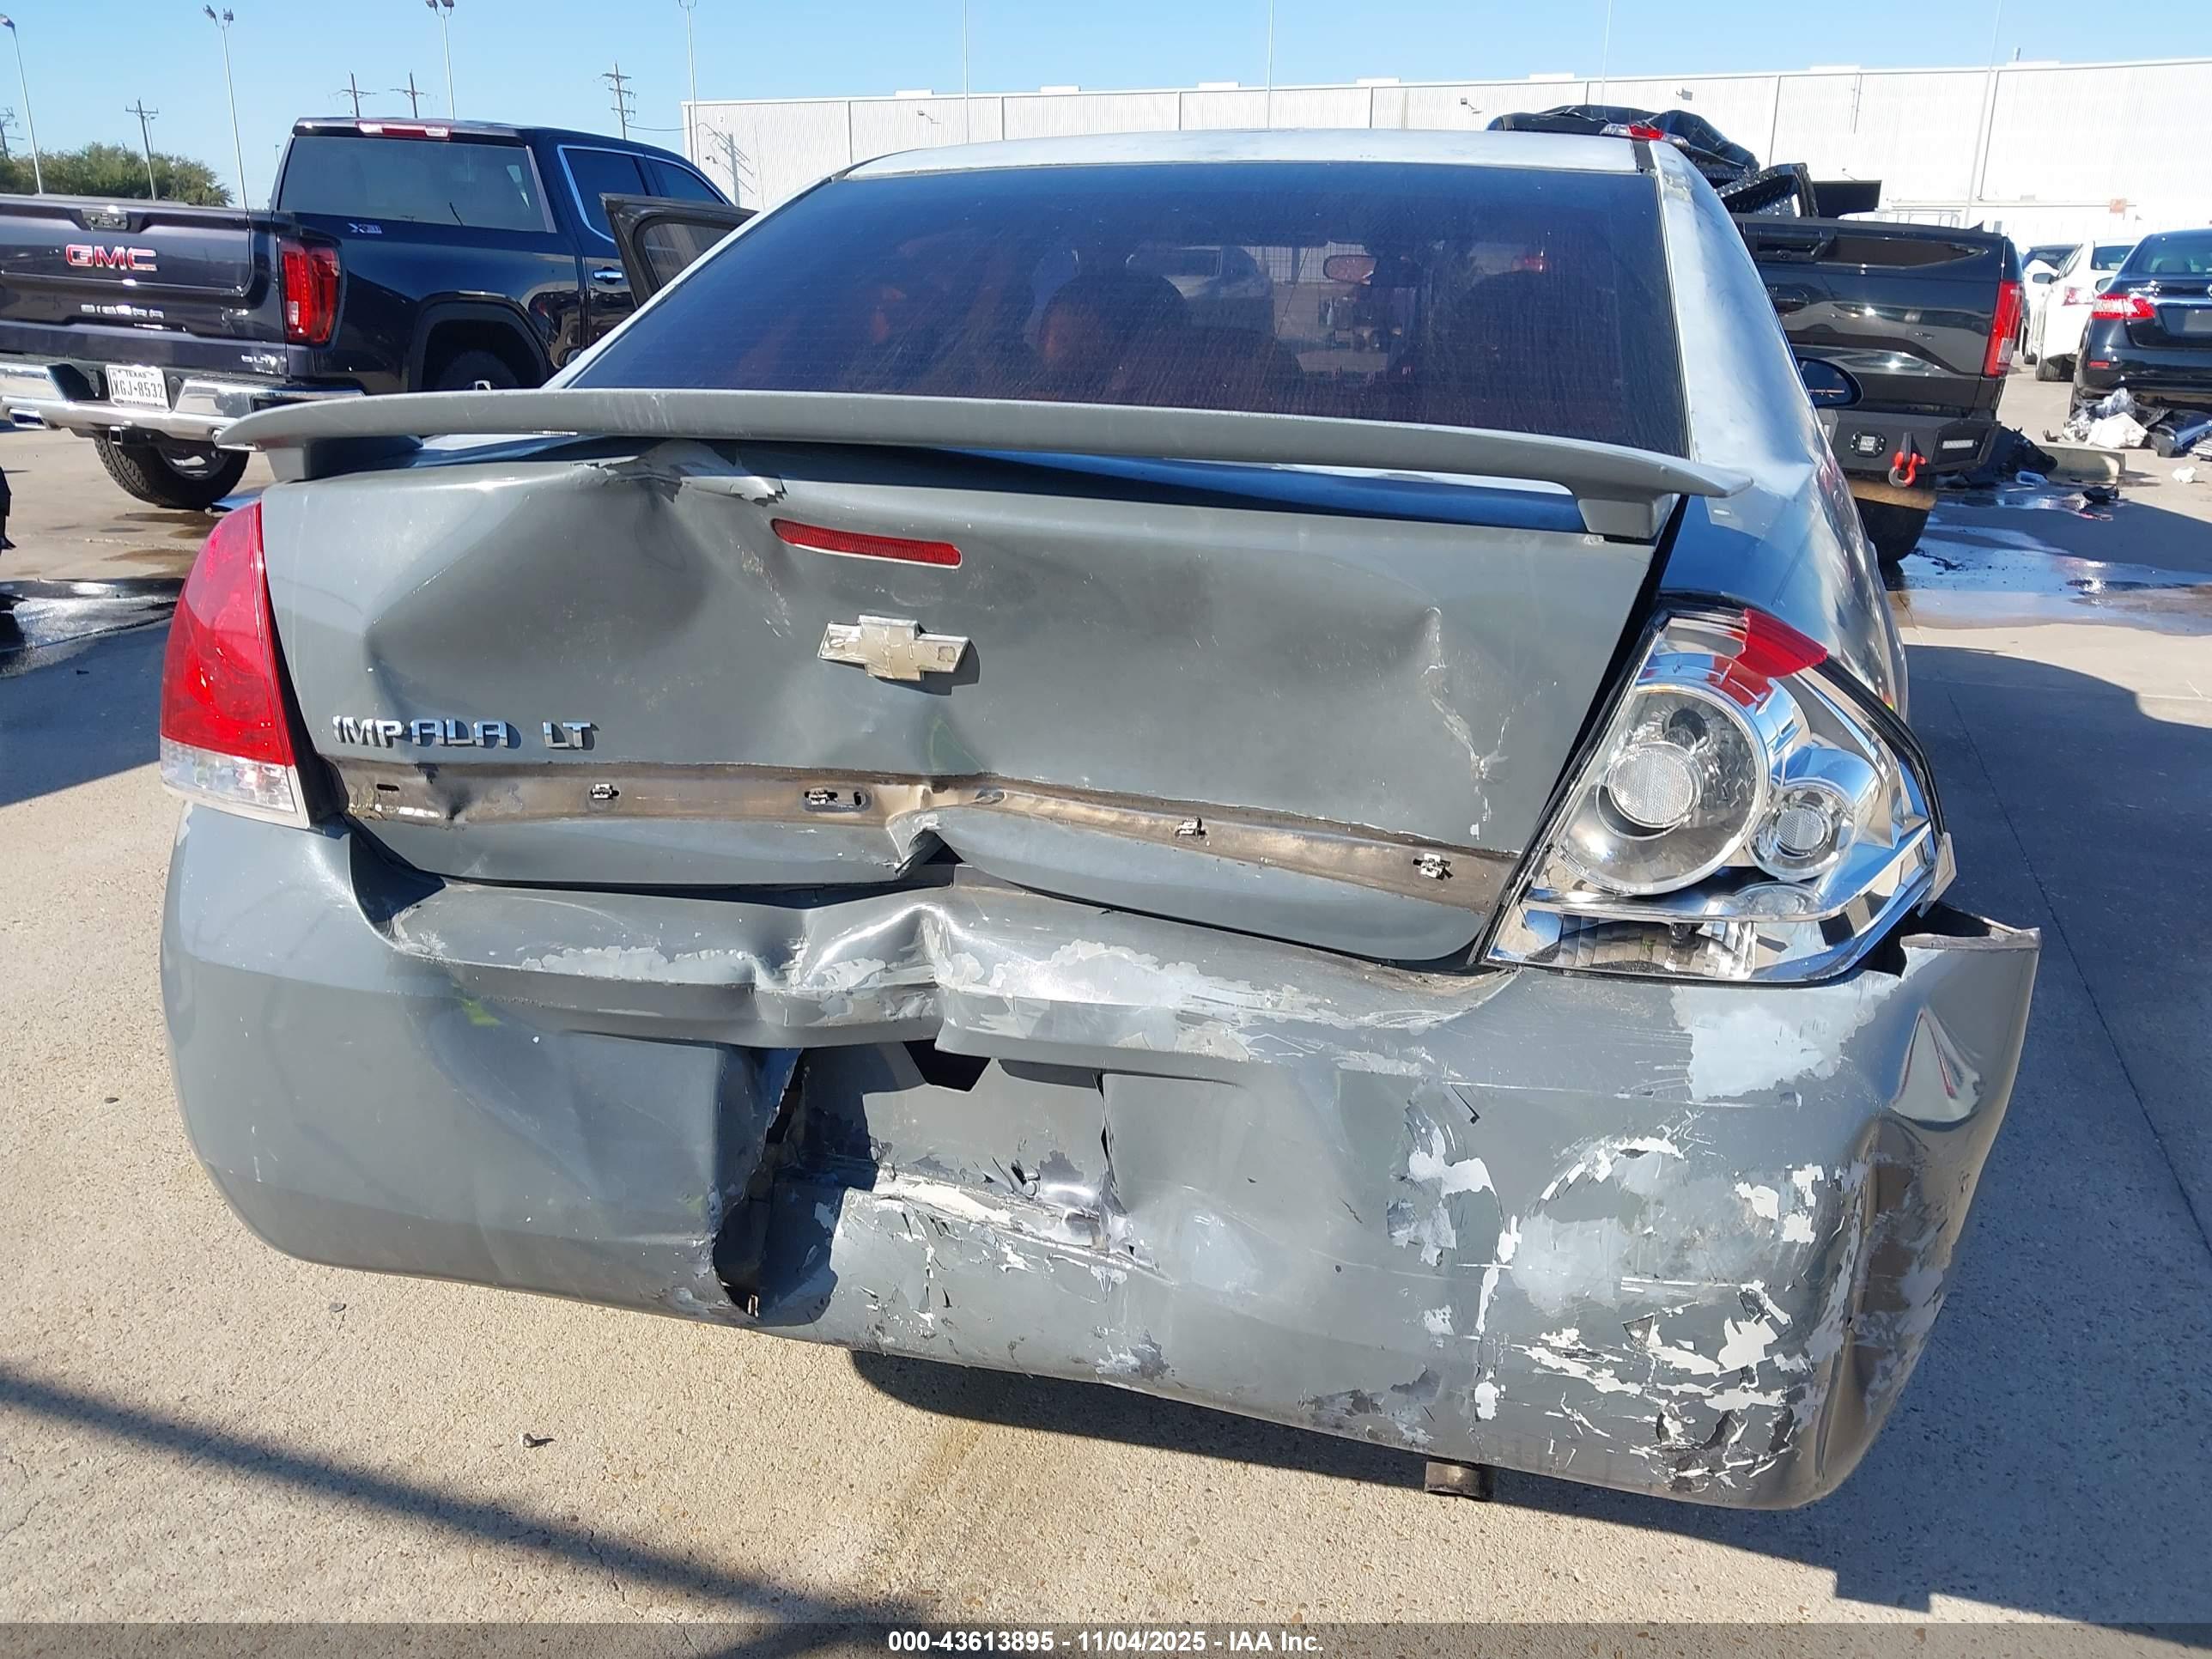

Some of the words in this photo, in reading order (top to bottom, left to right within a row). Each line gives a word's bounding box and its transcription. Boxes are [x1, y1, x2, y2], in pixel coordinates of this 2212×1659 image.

[66, 244, 158, 271] GMC
[332, 715, 508, 749] IMPALA
[543, 720, 592, 748] LT
